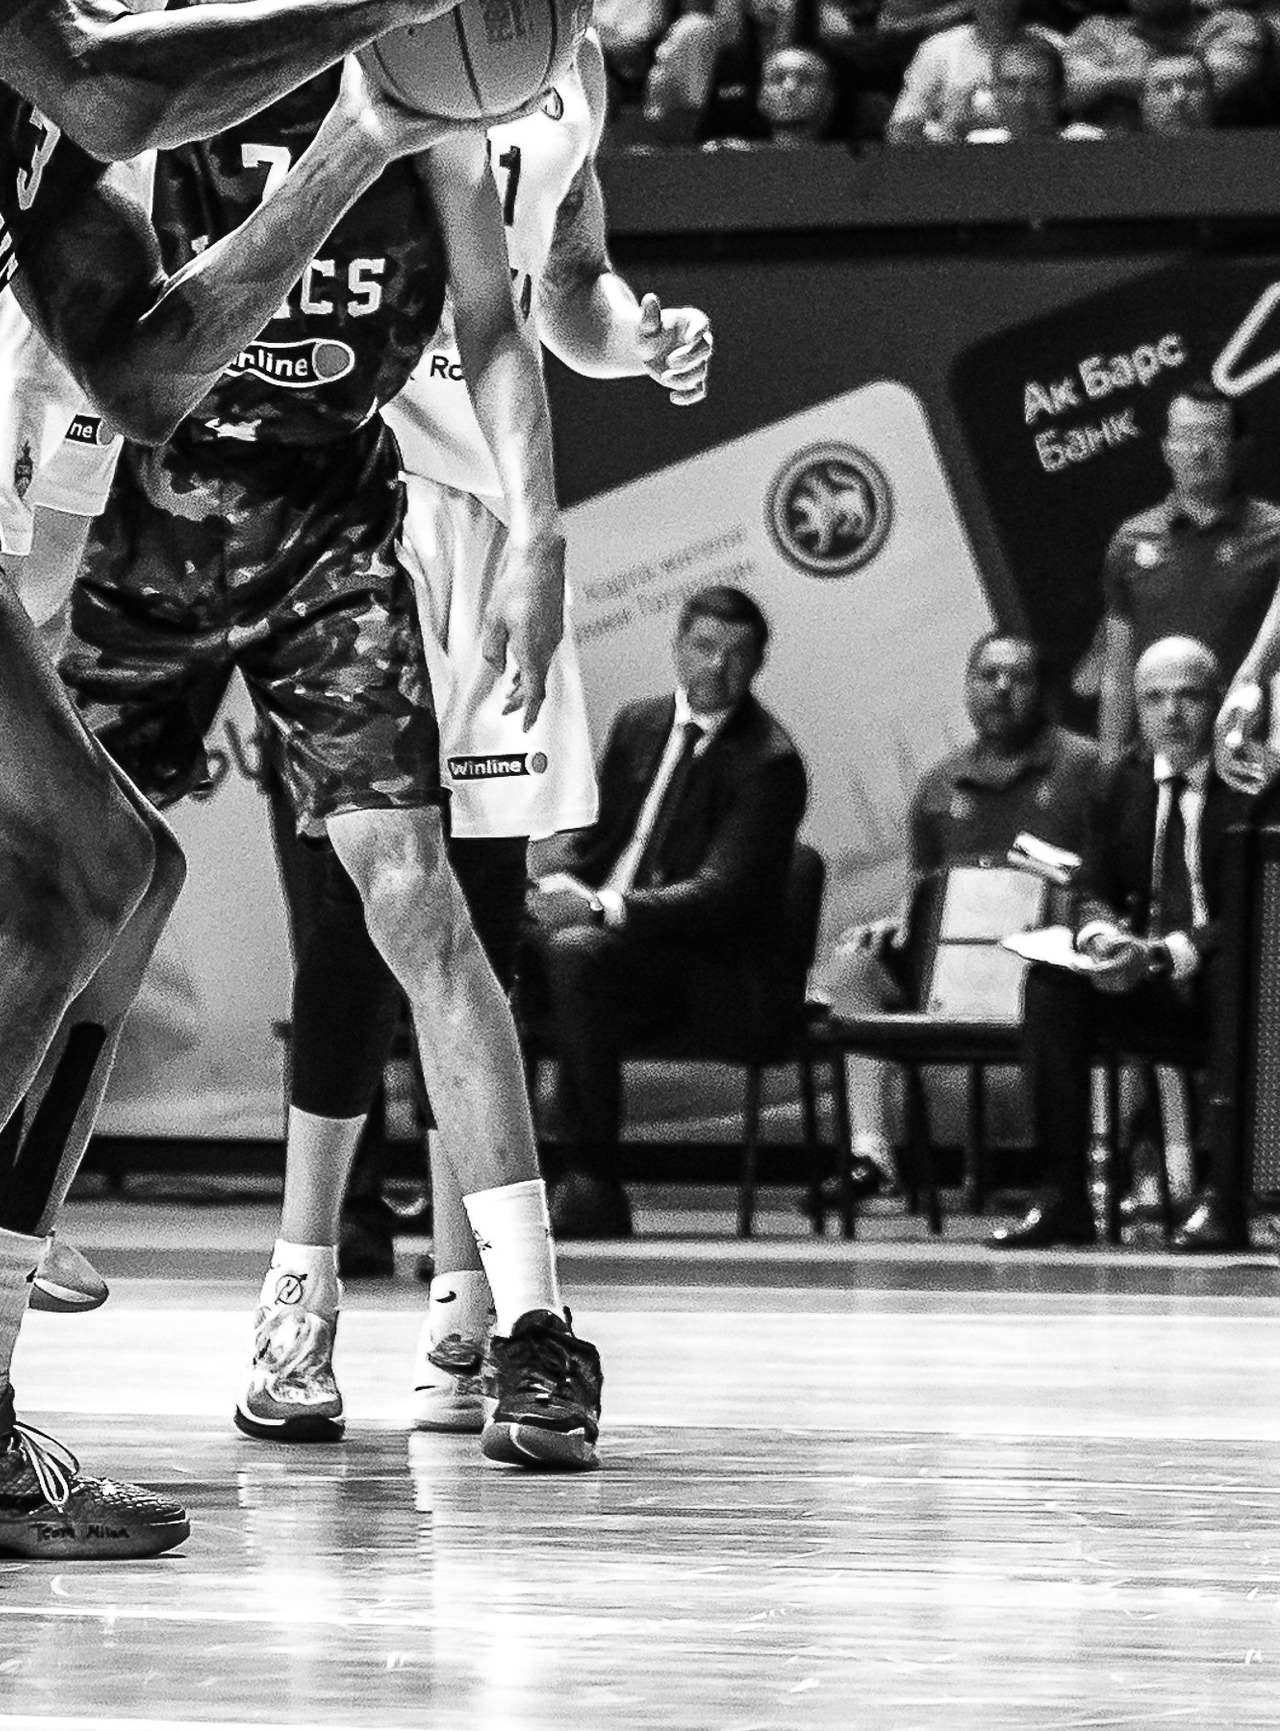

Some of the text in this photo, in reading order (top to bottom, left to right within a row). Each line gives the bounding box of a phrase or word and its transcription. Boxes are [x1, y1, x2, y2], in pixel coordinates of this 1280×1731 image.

[241, 143, 291, 203] 7
[1024, 332, 1187, 425] Ак Барс
[1034, 407, 1140, 473] Банк
[449, 759, 522, 776] Winline
